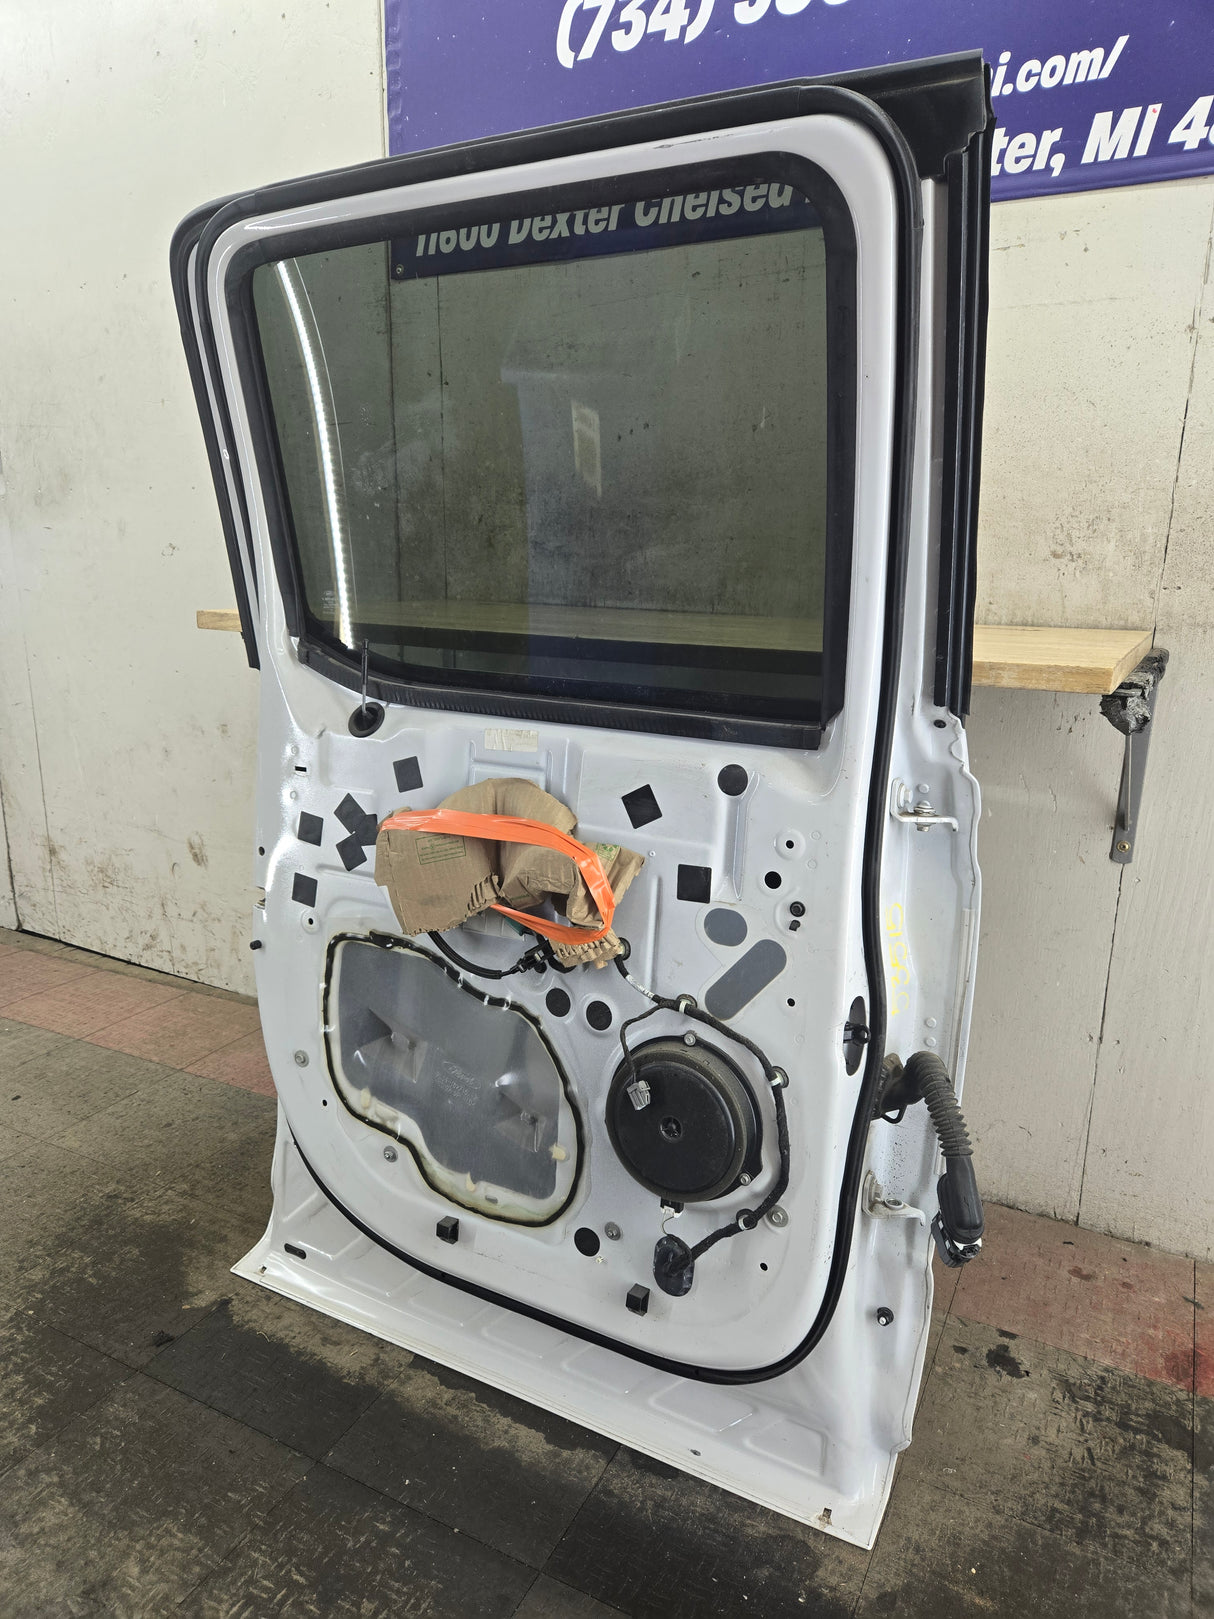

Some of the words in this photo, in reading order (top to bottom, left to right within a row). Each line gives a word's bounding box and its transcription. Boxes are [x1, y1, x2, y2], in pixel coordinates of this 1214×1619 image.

[990, 34, 1130, 97] i.com/
[508, 203, 626, 245] Dexter
[634, 182, 793, 227] Chelsea
[1080, 103, 1163, 165] MI
[1167, 94, 1214, 151] 4
